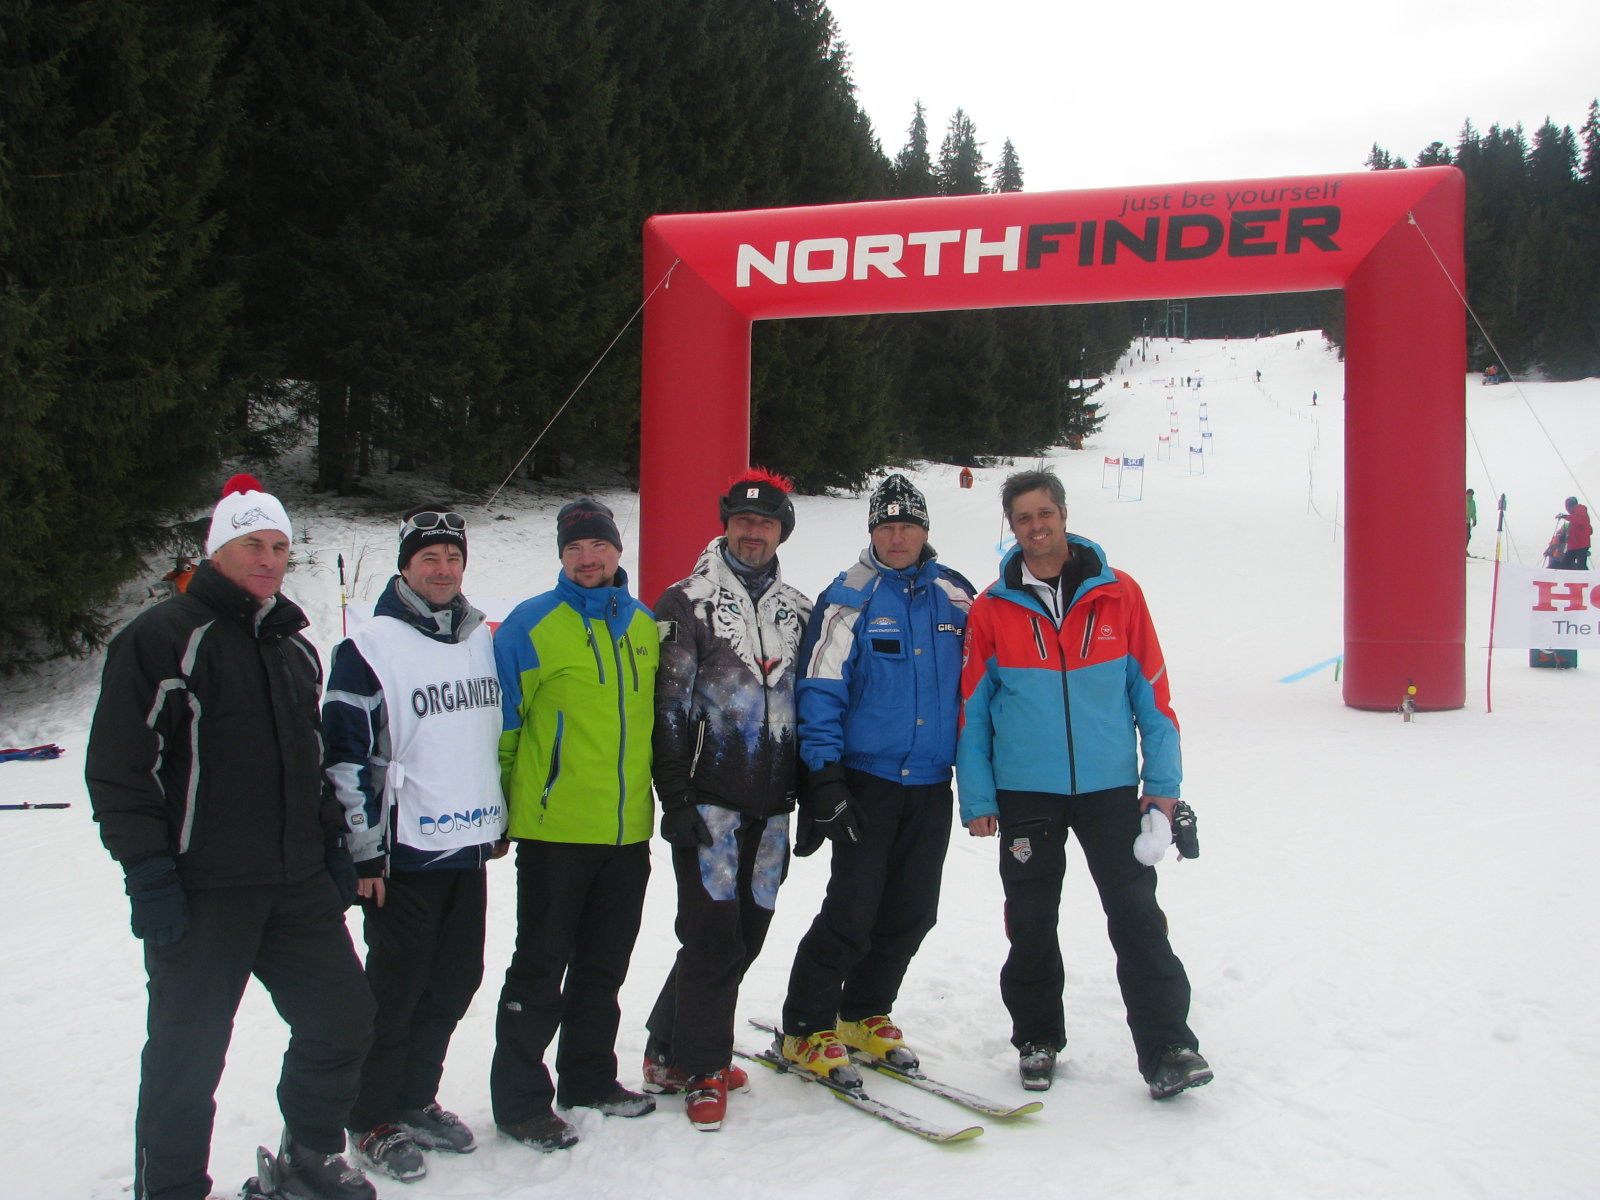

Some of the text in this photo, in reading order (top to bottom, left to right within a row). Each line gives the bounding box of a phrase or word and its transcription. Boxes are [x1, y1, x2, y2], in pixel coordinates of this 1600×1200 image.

[1117, 181, 1343, 217] just be yourself
[736, 205, 1343, 288] NORTHFINDER
[1552, 620, 1591, 635] The
